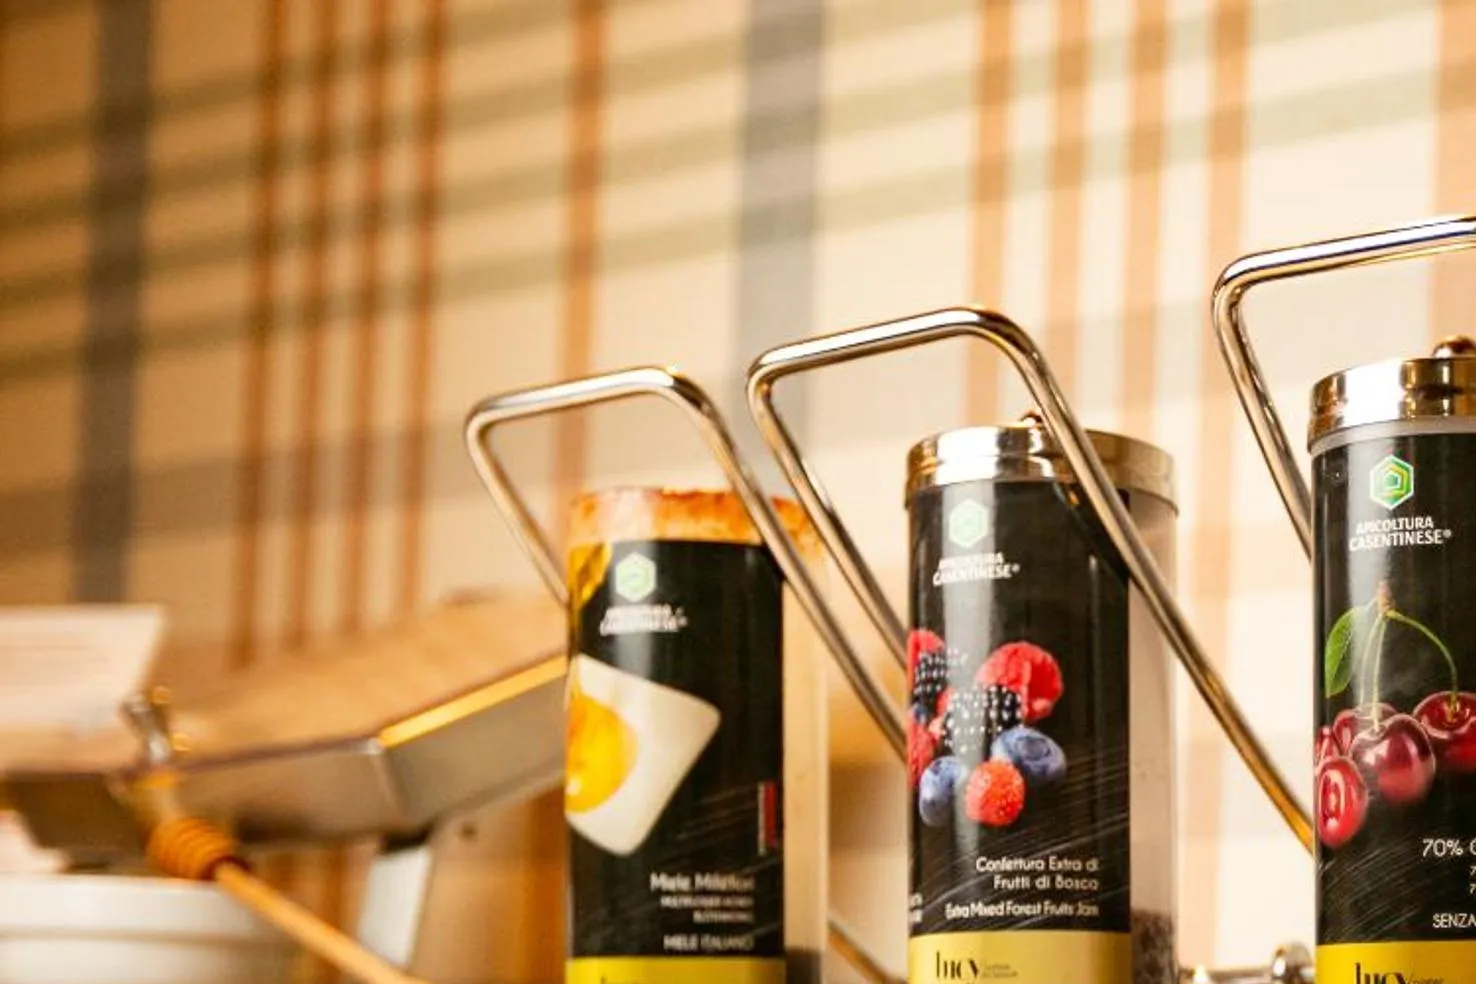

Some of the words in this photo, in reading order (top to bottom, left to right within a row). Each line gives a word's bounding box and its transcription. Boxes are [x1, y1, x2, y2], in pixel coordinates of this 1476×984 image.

[1421, 838, 1464, 858] 70%
[975, 855, 1045, 872] Confettura
[1049, 856, 1082, 872] Extra
[1086, 857, 1099, 872] di
[994, 875, 1031, 890] Frutti
[1036, 875, 1050, 889] di
[1055, 875, 1099, 890] Bosco
[971, 901, 1005, 917] Mixed
[1006, 901, 1042, 916] Forest
[1044, 901, 1074, 915] Fruits
[1076, 901, 1099, 916] Jam
[1432, 913, 1476, 929] SENZA
